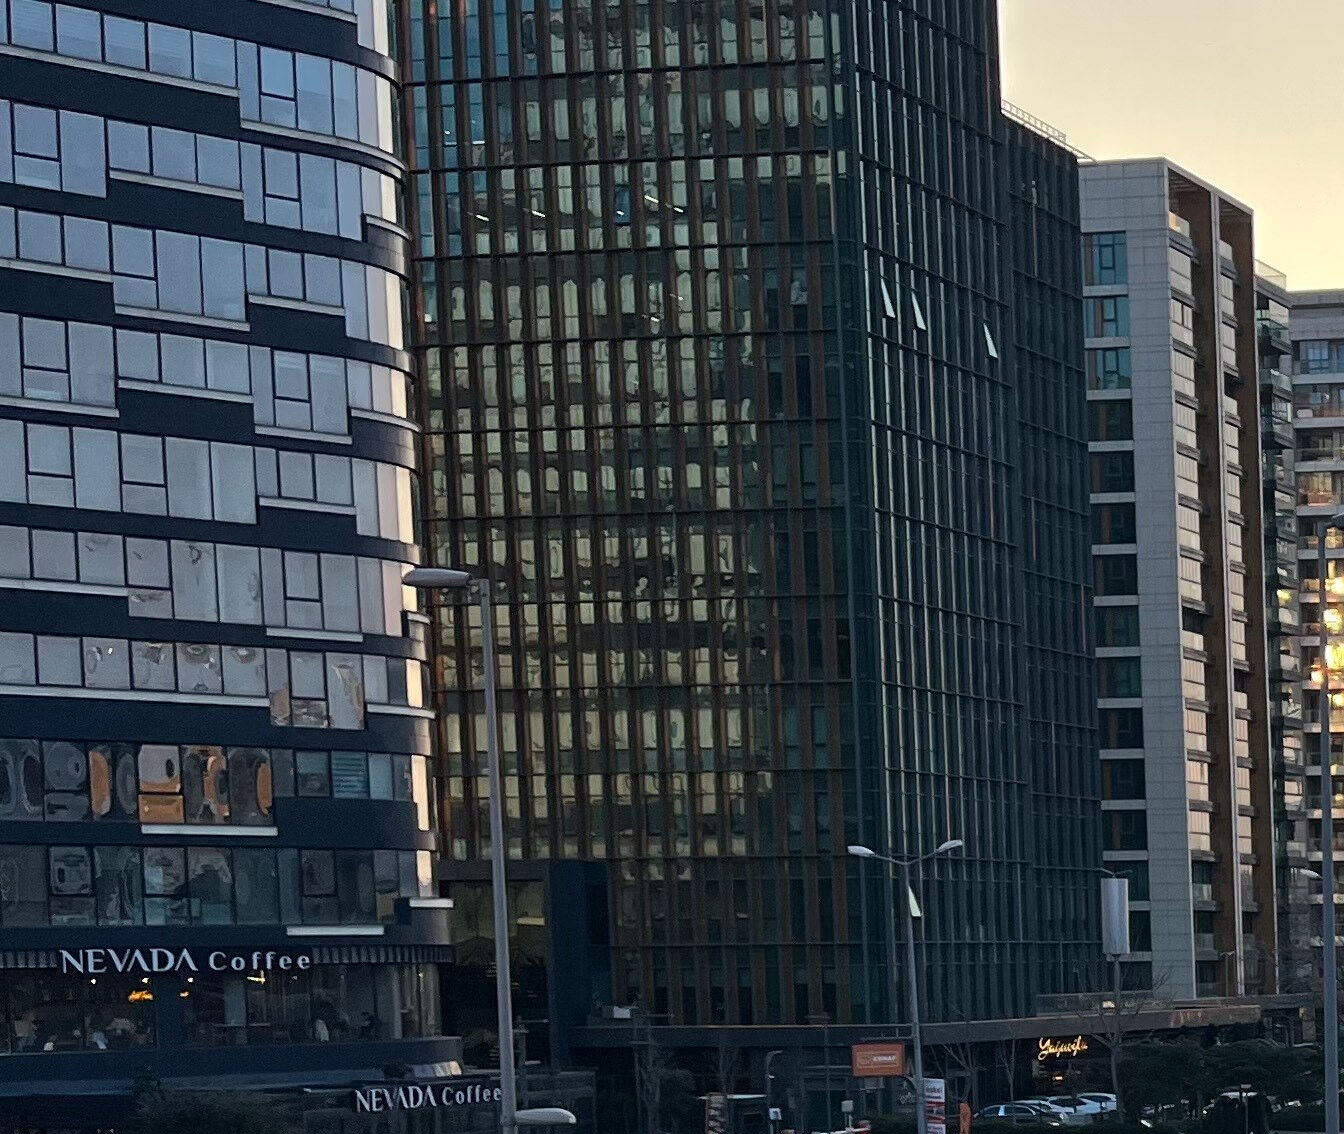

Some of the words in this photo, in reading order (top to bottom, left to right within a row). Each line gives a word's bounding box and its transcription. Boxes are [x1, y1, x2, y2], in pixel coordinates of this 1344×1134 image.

[59, 948, 198, 973] NEVADA
[208, 950, 311, 971] Coffee
[355, 1085, 437, 1113] NEVADA
[441, 1084, 501, 1106] Coffee
